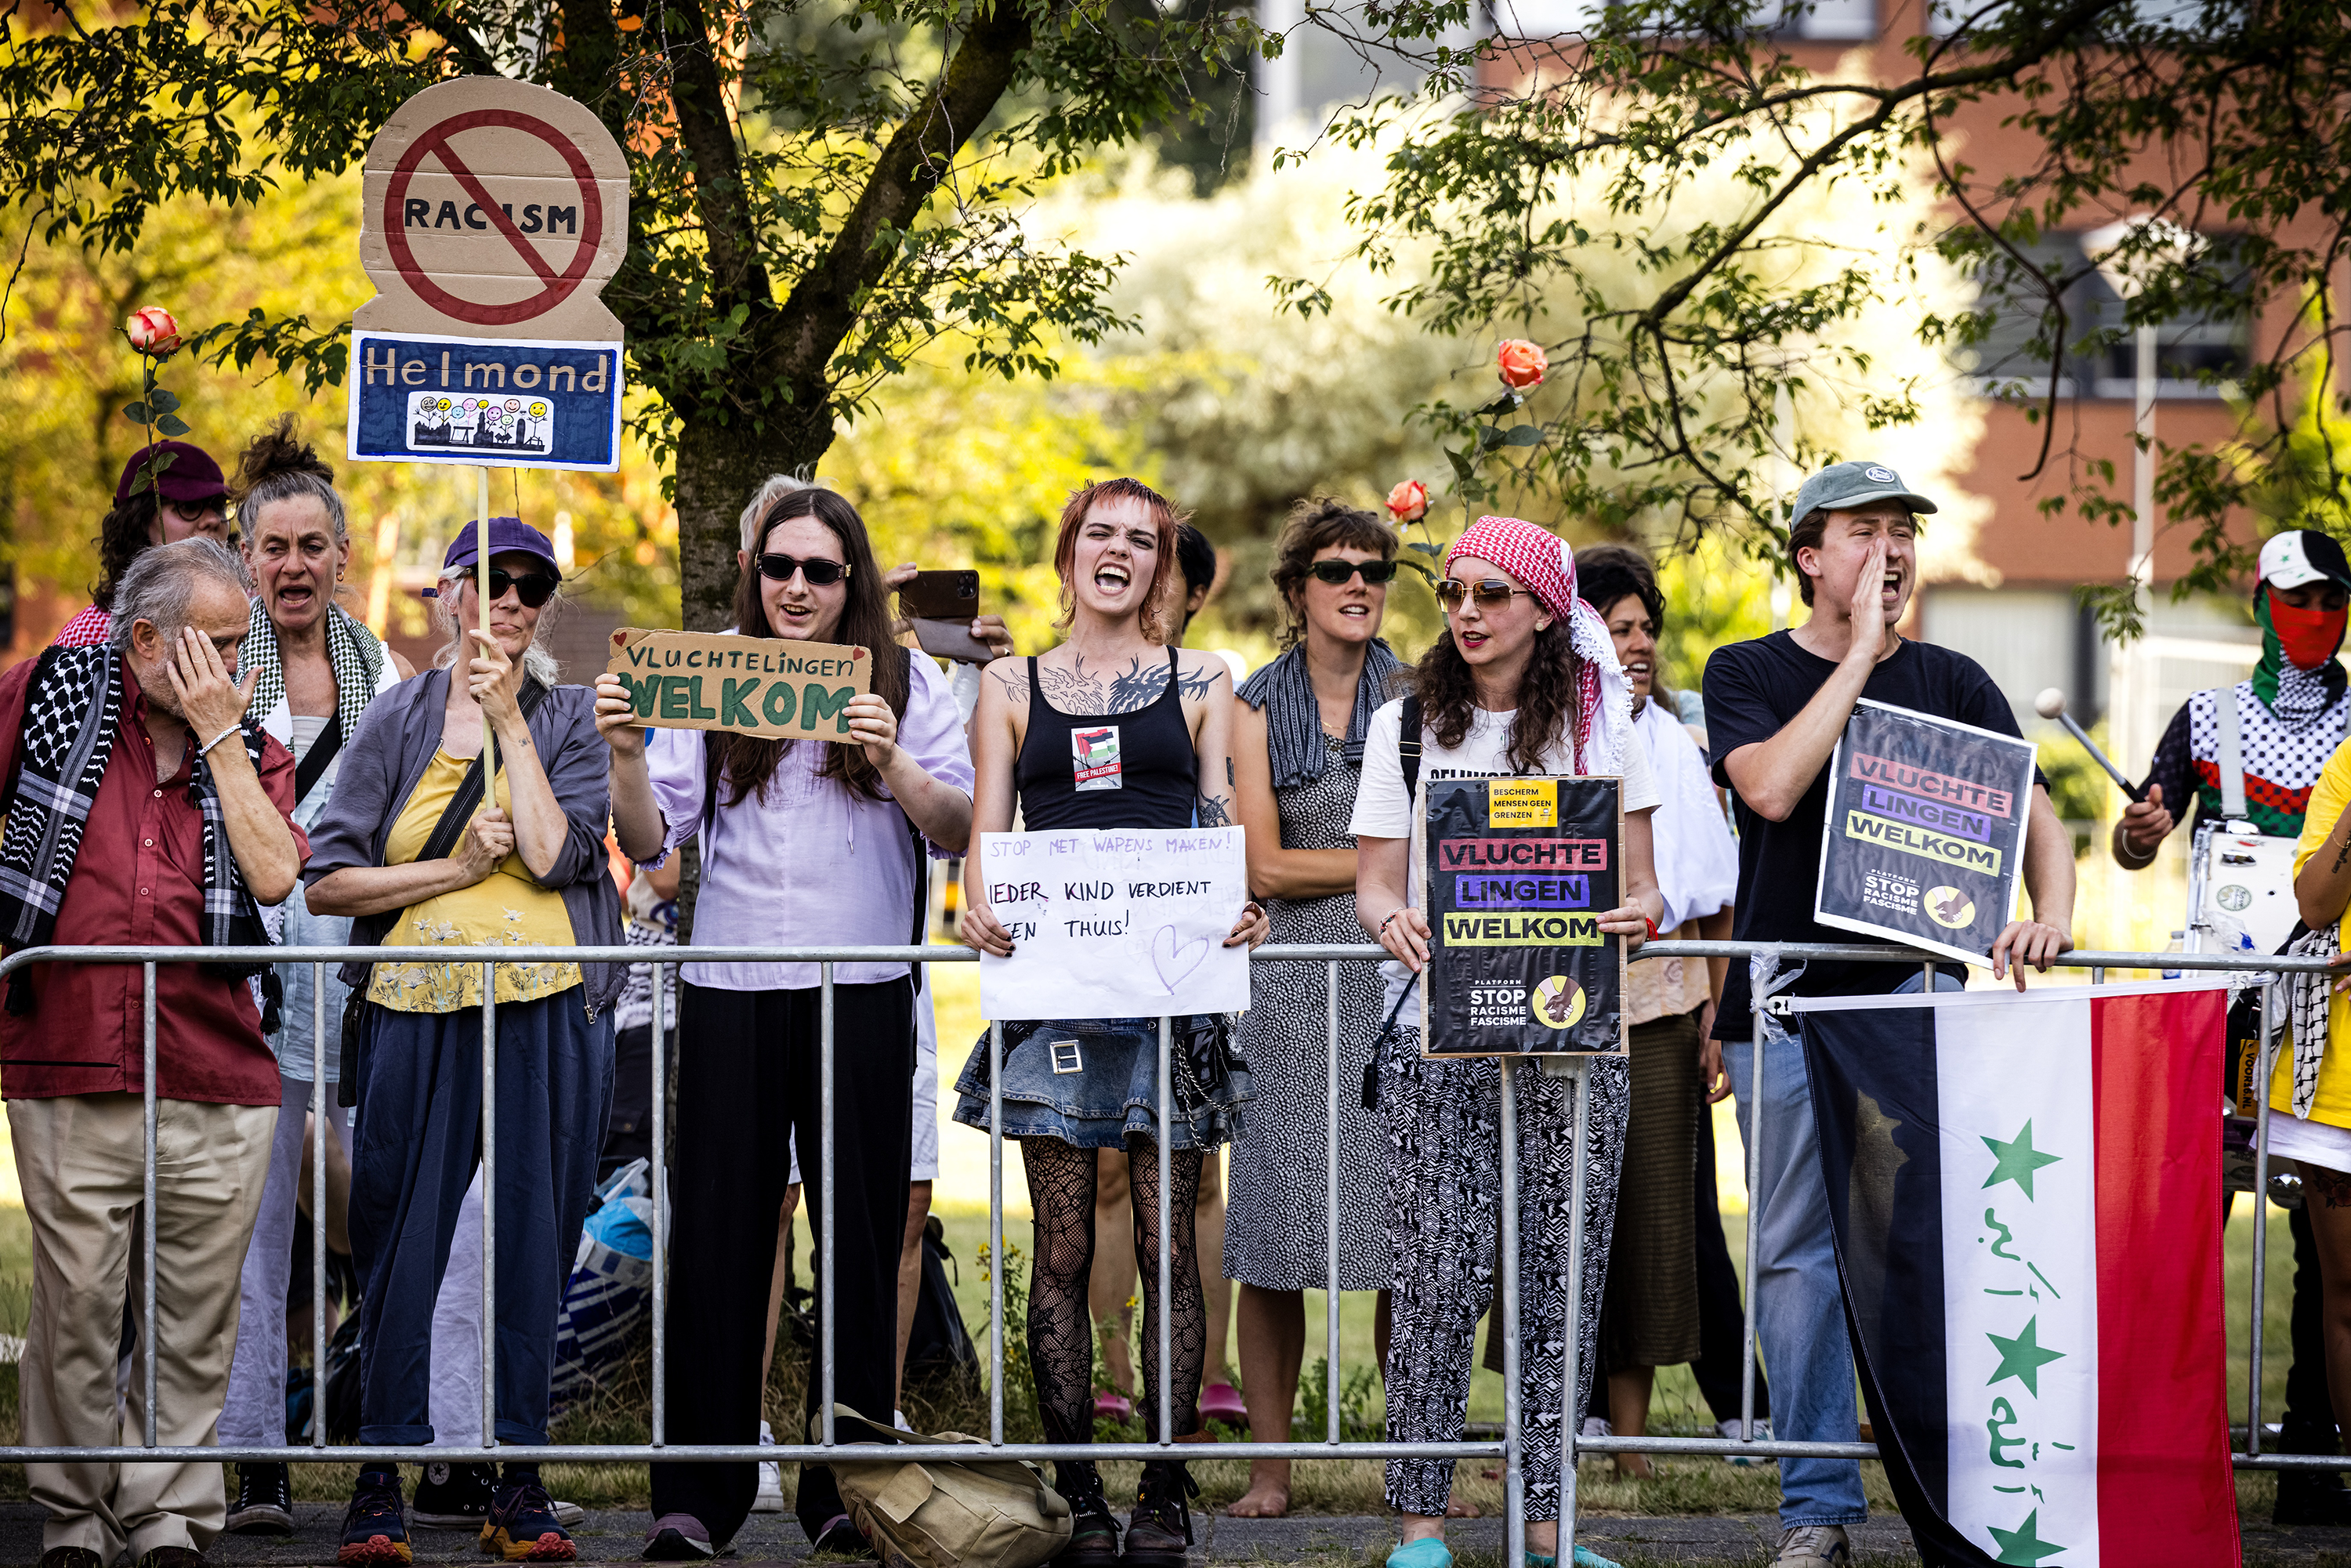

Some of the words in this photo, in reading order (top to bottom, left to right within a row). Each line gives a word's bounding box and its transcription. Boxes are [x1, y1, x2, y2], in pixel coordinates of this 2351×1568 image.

[366, 348, 607, 393] Helmond
[618, 672, 856, 733] WELKOM
[1078, 771, 1090, 780] FREE
[1090, 766, 1118, 777] PALESTINE!
[1857, 757, 2007, 812] VLUCHTE
[1868, 790, 1983, 835] LINGEN
[991, 840, 1031, 857] STOP
[1049, 838, 1079, 856] MET
[1093, 837, 1153, 853] WAPENS
[1166, 831, 1231, 853] MAKEN!
[1851, 815, 1994, 868] WELKOM
[1443, 844, 1601, 864] VLUCHTE
[1866, 875, 1919, 896] STOP
[1871, 868, 1916, 884] PLATFORM
[990, 882, 1049, 904] IEDER
[1064, 881, 1114, 901] KIND
[1128, 882, 1212, 899] VERDIENT
[1462, 880, 1581, 901] LINGEN
[1864, 887, 1918, 907] RACISME
[1864, 895, 1917, 915] FASCISME
[1002, 922, 1036, 941] EN
[1064, 909, 1129, 938] THUIS!
[1447, 918, 1597, 940] WELKOM
[1470, 990, 1527, 1005] STOP
[1471, 1006, 1526, 1016] RACISME
[1471, 1017, 1526, 1026] FASCISME
